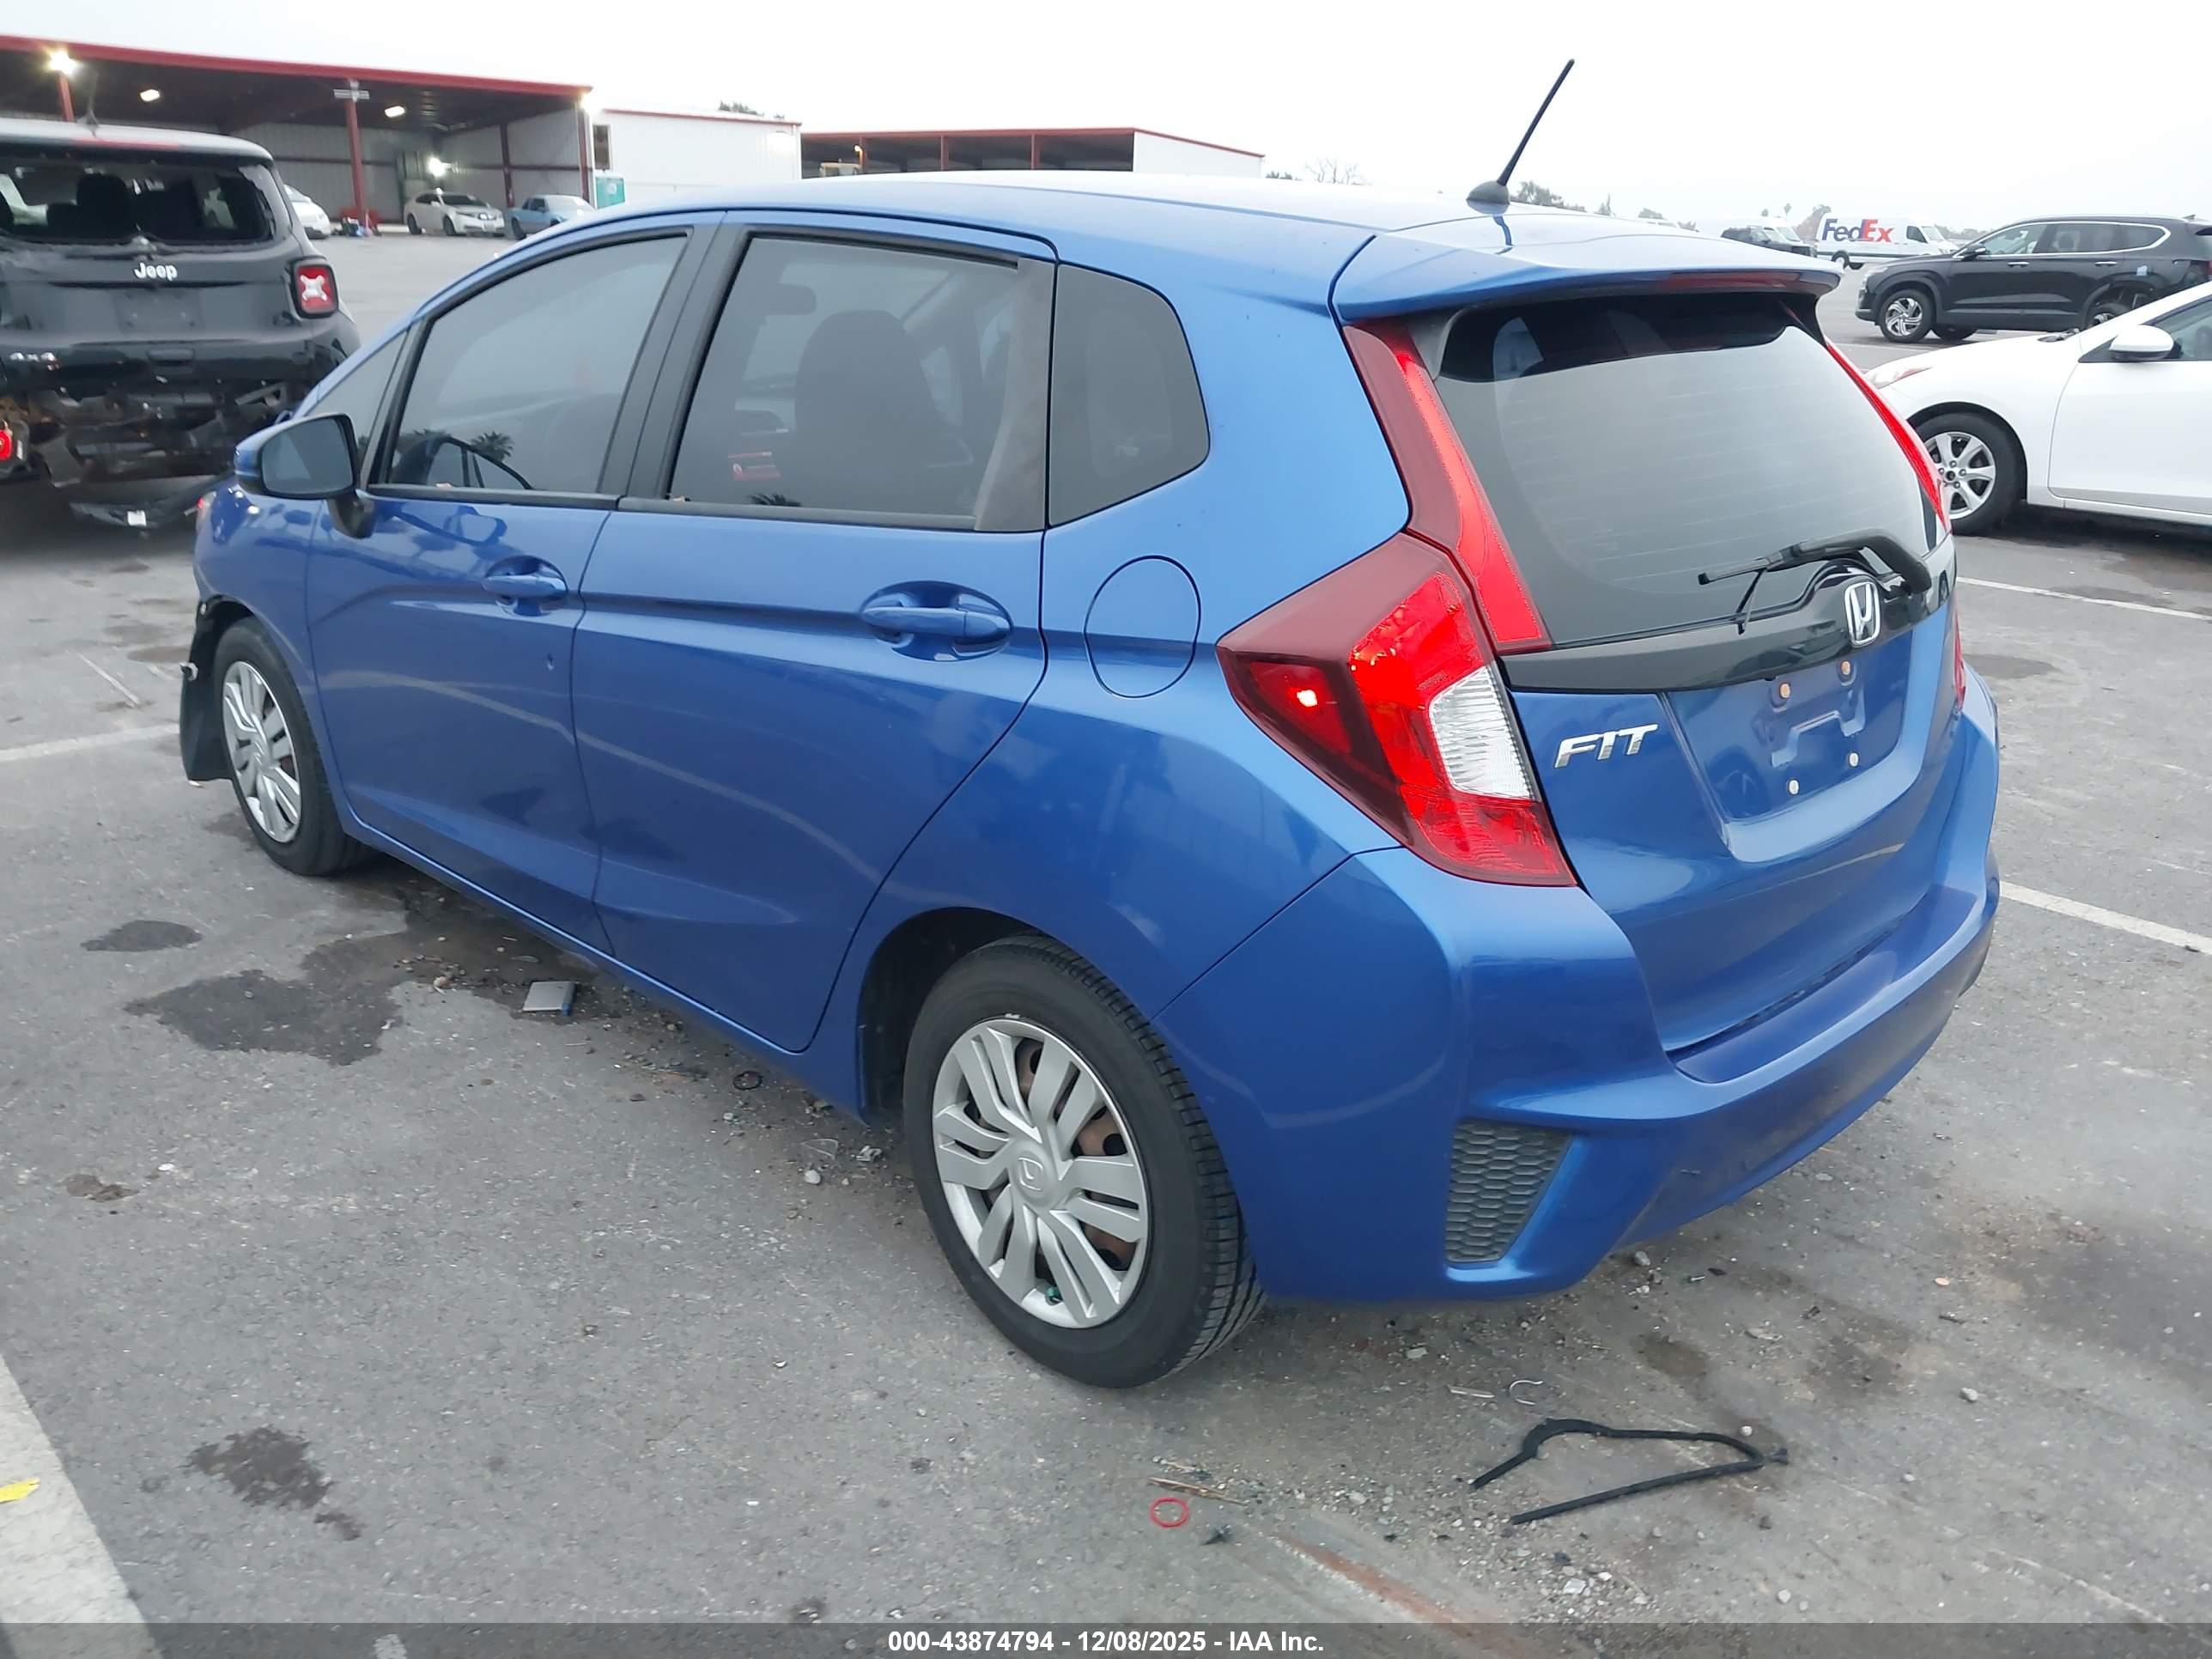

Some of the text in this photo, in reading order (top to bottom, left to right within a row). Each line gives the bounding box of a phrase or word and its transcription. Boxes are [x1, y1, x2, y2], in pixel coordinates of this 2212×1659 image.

[1822, 218, 1894, 242] FedEx
[133, 262, 178, 281] Jeep
[1554, 724, 1658, 768] FIT
